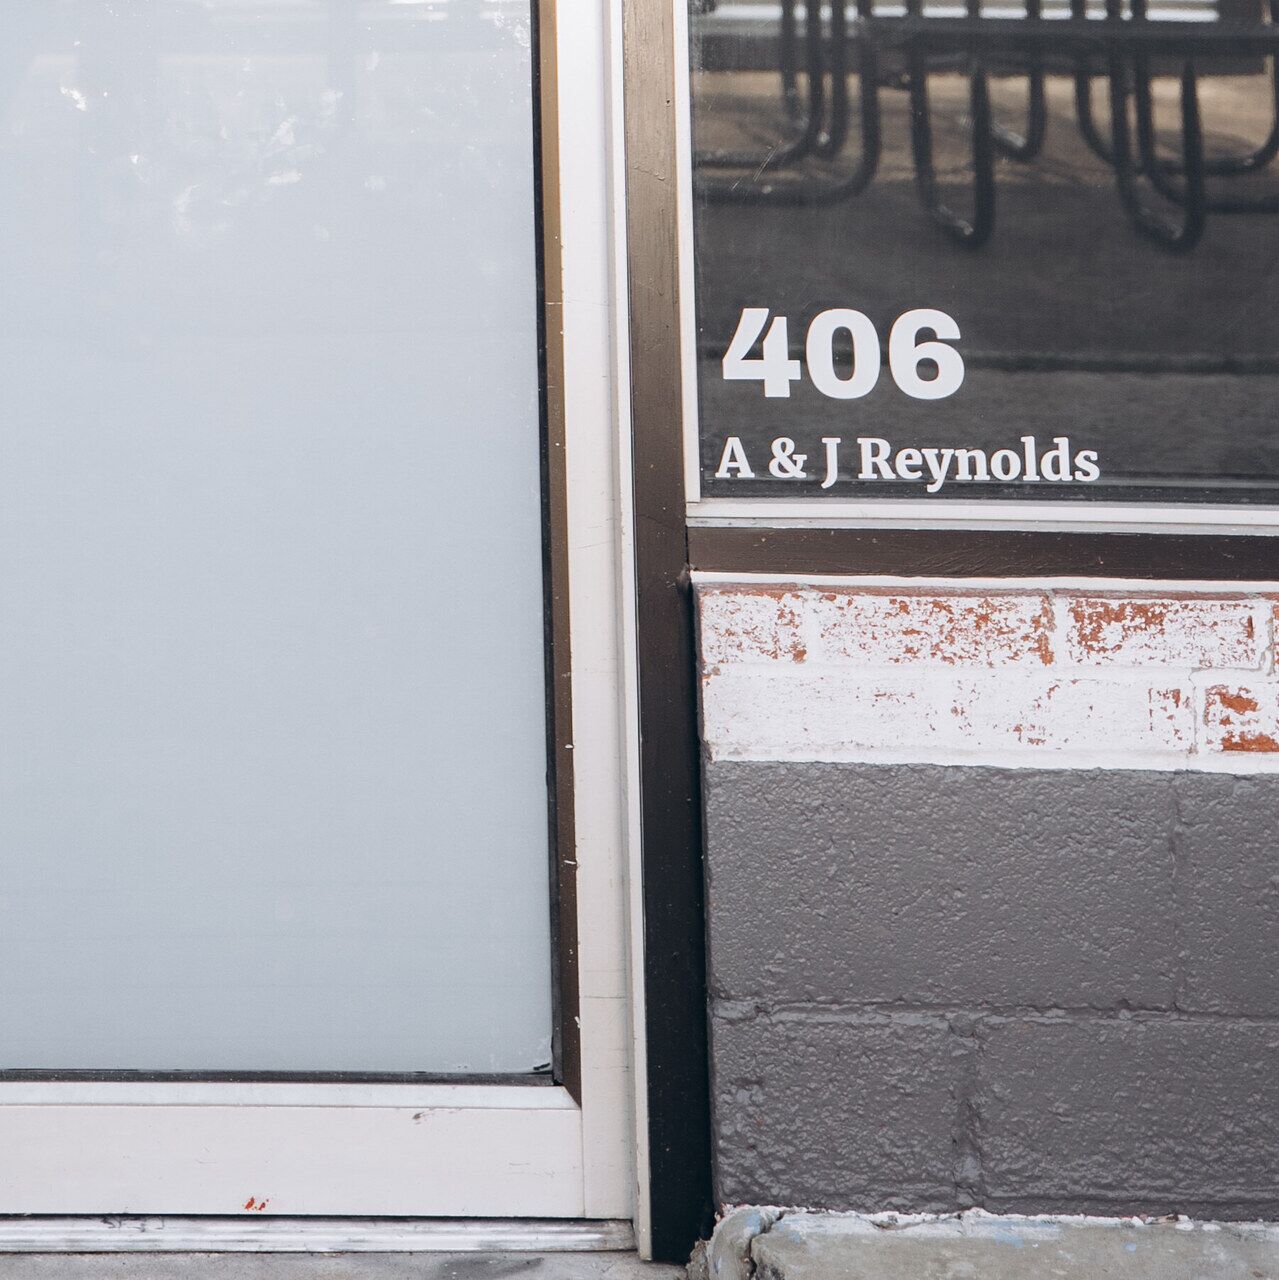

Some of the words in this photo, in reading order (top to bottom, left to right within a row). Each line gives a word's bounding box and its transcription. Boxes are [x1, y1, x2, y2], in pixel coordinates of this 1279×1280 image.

[722, 307, 965, 400] 406
[715, 436, 756, 479] A
[768, 436, 808, 479] &
[820, 437, 842, 490] J
[856, 435, 1101, 493] Reynolds
